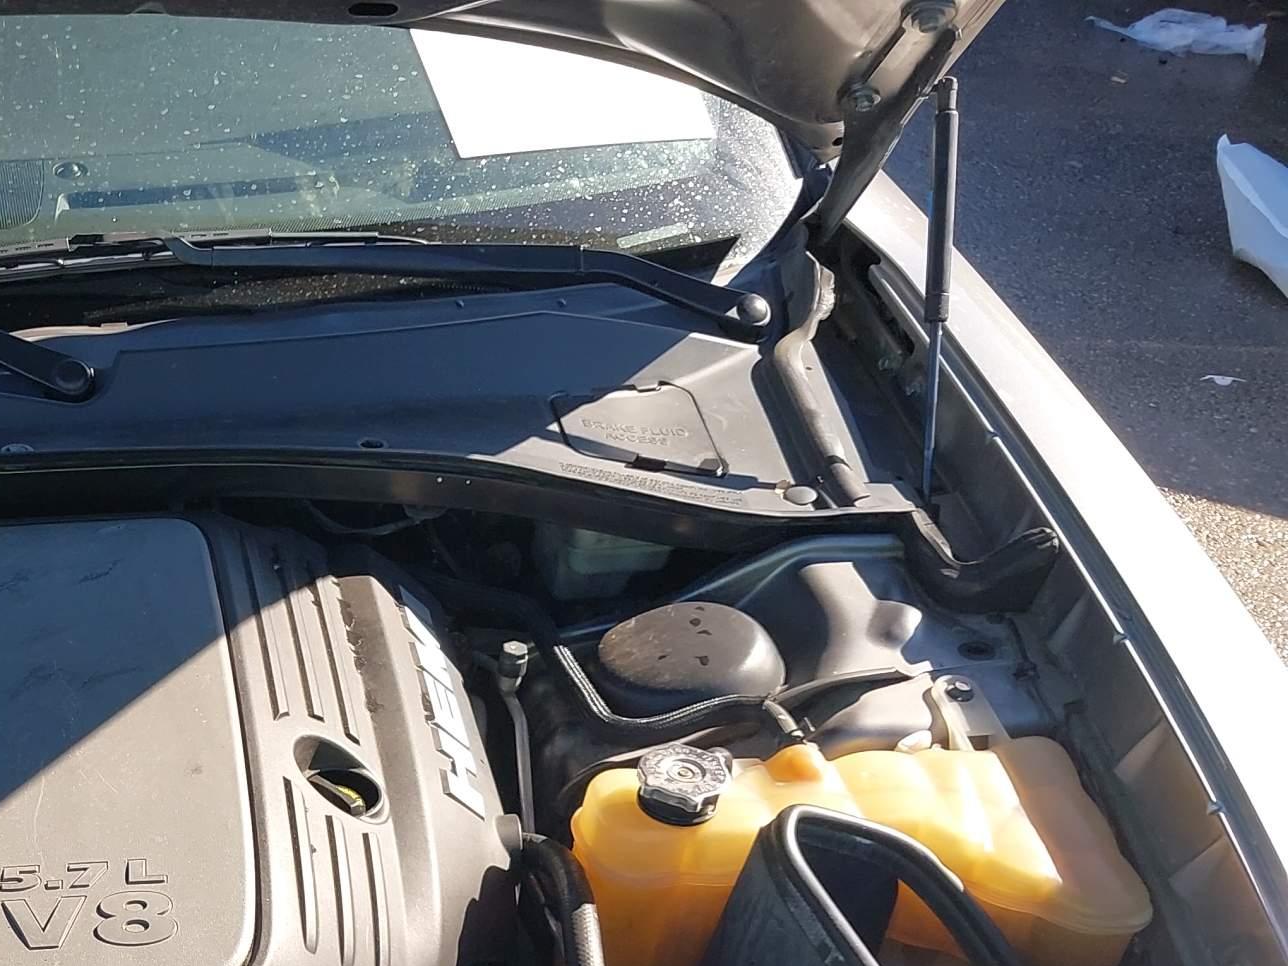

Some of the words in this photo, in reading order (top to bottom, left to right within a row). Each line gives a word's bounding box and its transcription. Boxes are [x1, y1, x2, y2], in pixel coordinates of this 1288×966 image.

[580, 418, 637, 435] BRAKE
[639, 425, 689, 438] FLUID
[604, 432, 671, 447] ACCESS
[395, 584, 487, 822] HEMI
[0, 890, 179, 951] V8
